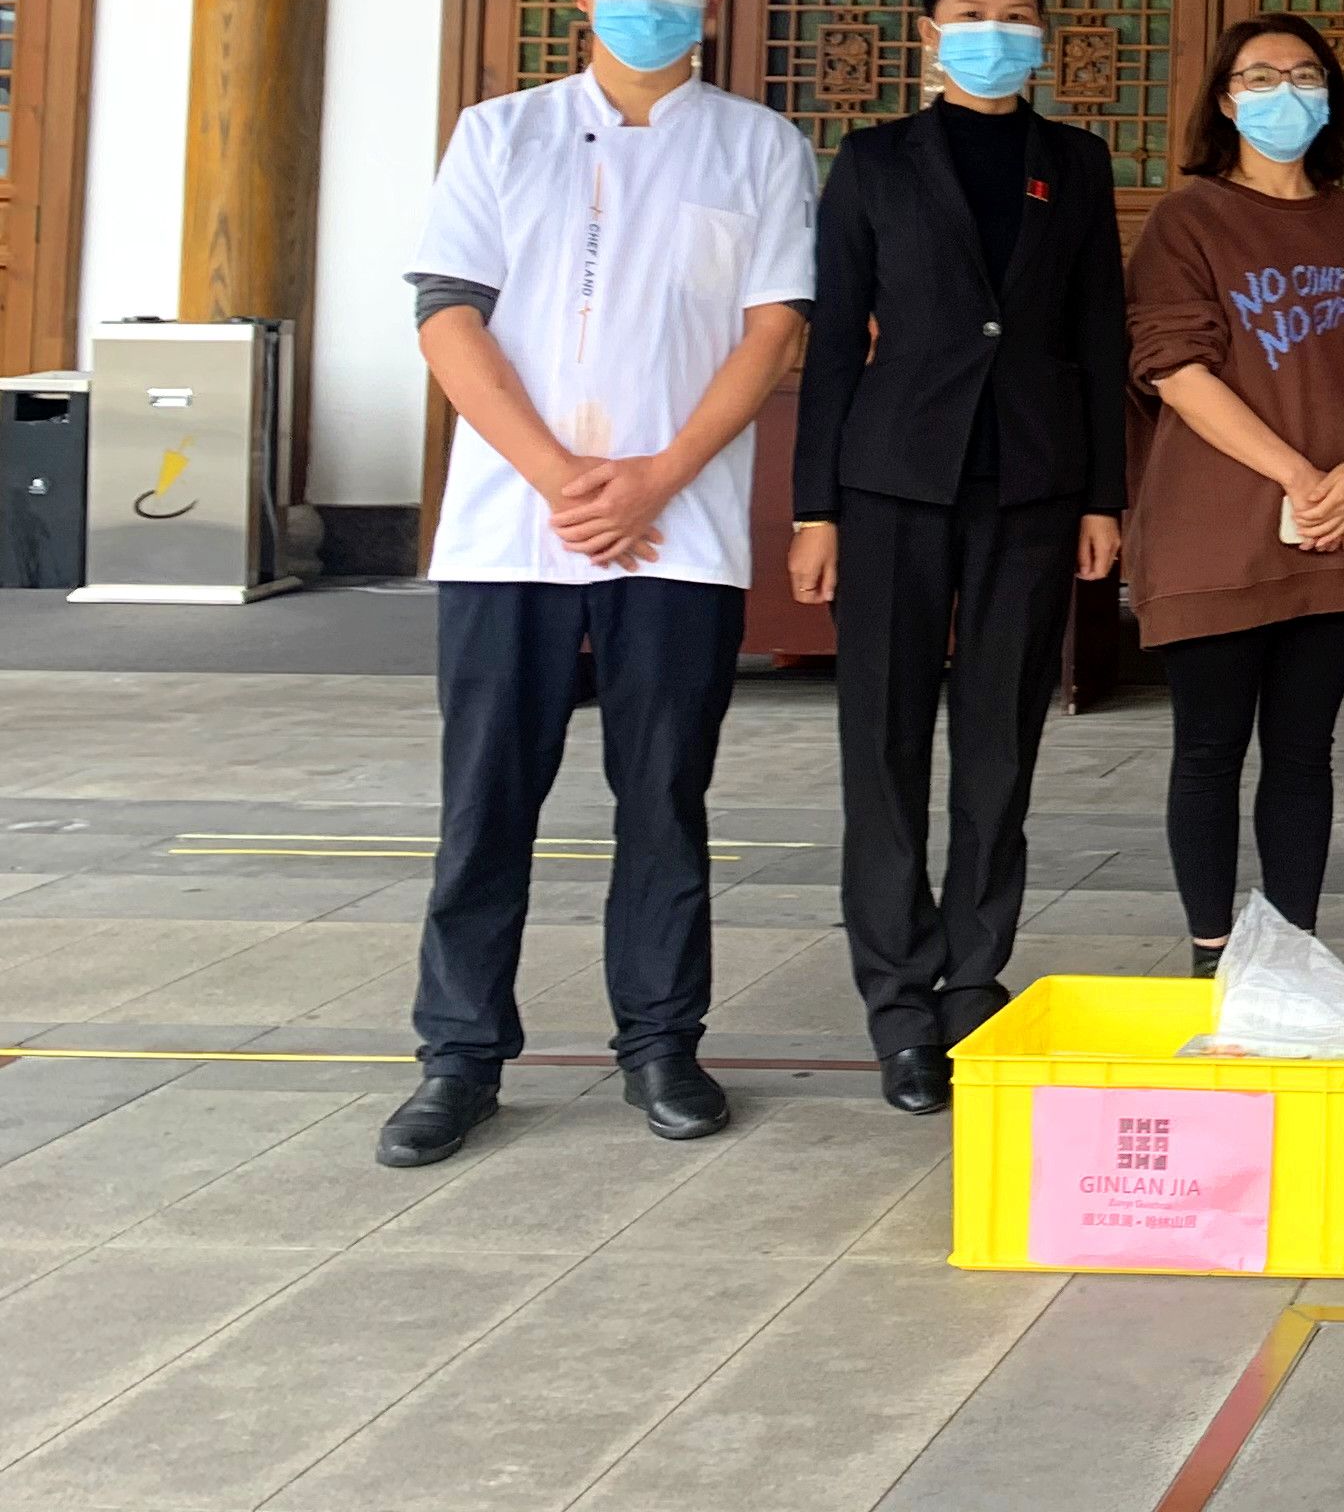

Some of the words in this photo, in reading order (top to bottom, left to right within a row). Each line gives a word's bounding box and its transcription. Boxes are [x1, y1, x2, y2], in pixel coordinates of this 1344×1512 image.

[586, 223, 601, 256] CHEF
[582, 260, 596, 297] LAND
[1228, 267, 1287, 331] NO
[1255, 305, 1311, 371] NO
[1080, 1175, 1165, 1195] GINLAN
[1169, 1177, 1201, 1196] JIA
